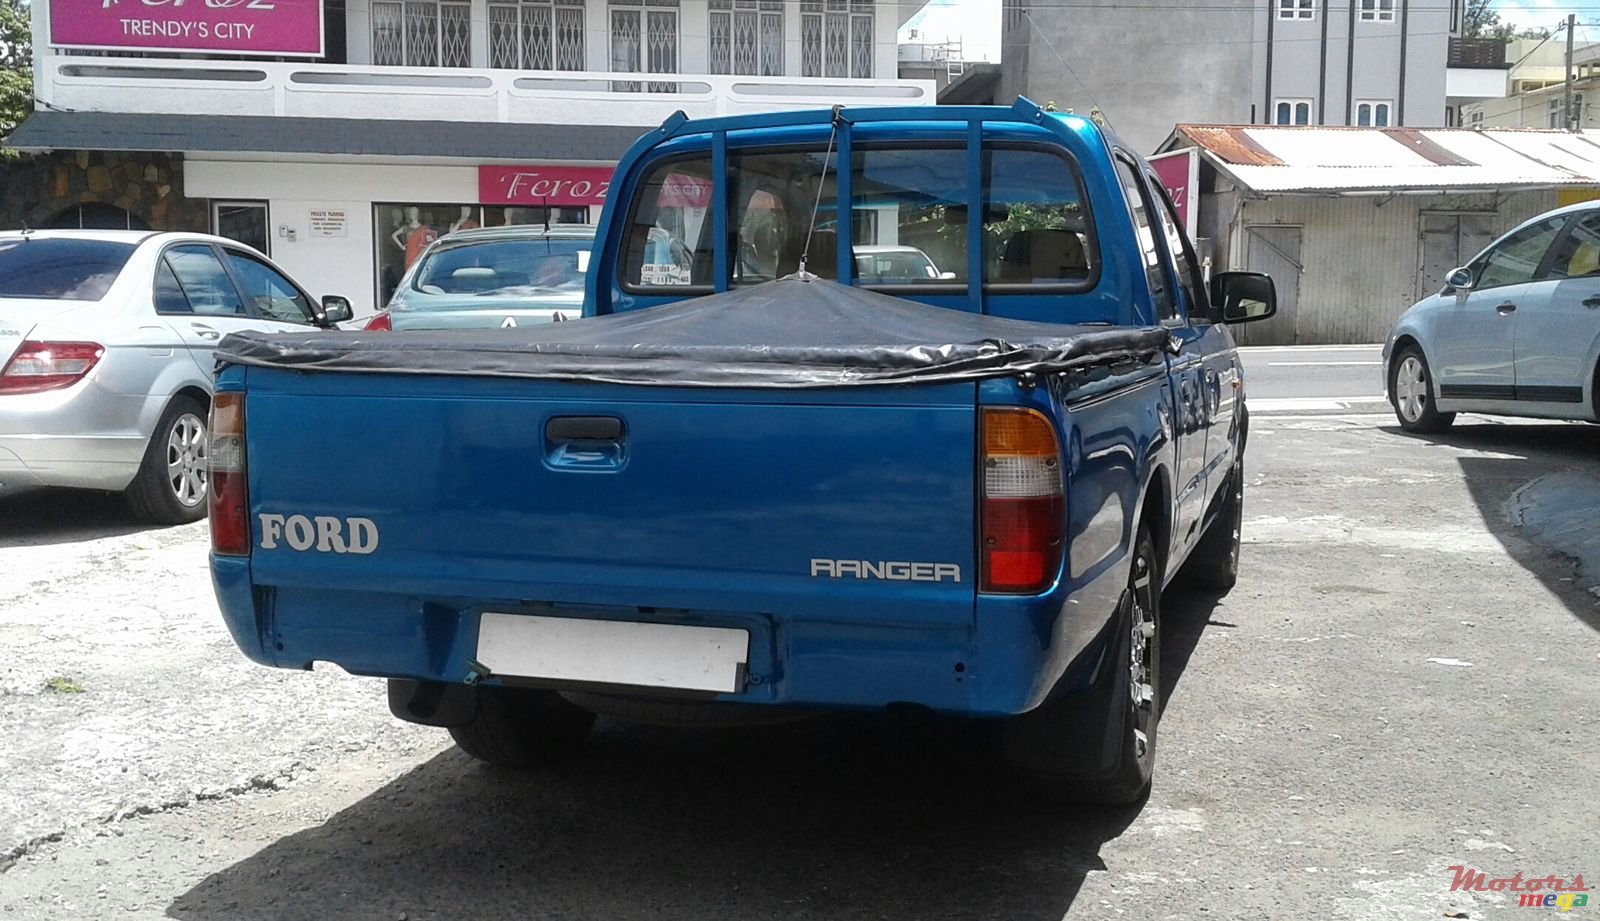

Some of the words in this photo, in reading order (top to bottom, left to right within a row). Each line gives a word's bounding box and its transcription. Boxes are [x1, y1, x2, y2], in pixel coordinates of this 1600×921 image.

[120, 18, 209, 39] TRENDY'S
[214, 22, 255, 39] CITY
[500, 172, 610, 199] Feroz
[258, 513, 379, 554] FORD
[810, 558, 961, 583] RANGER
